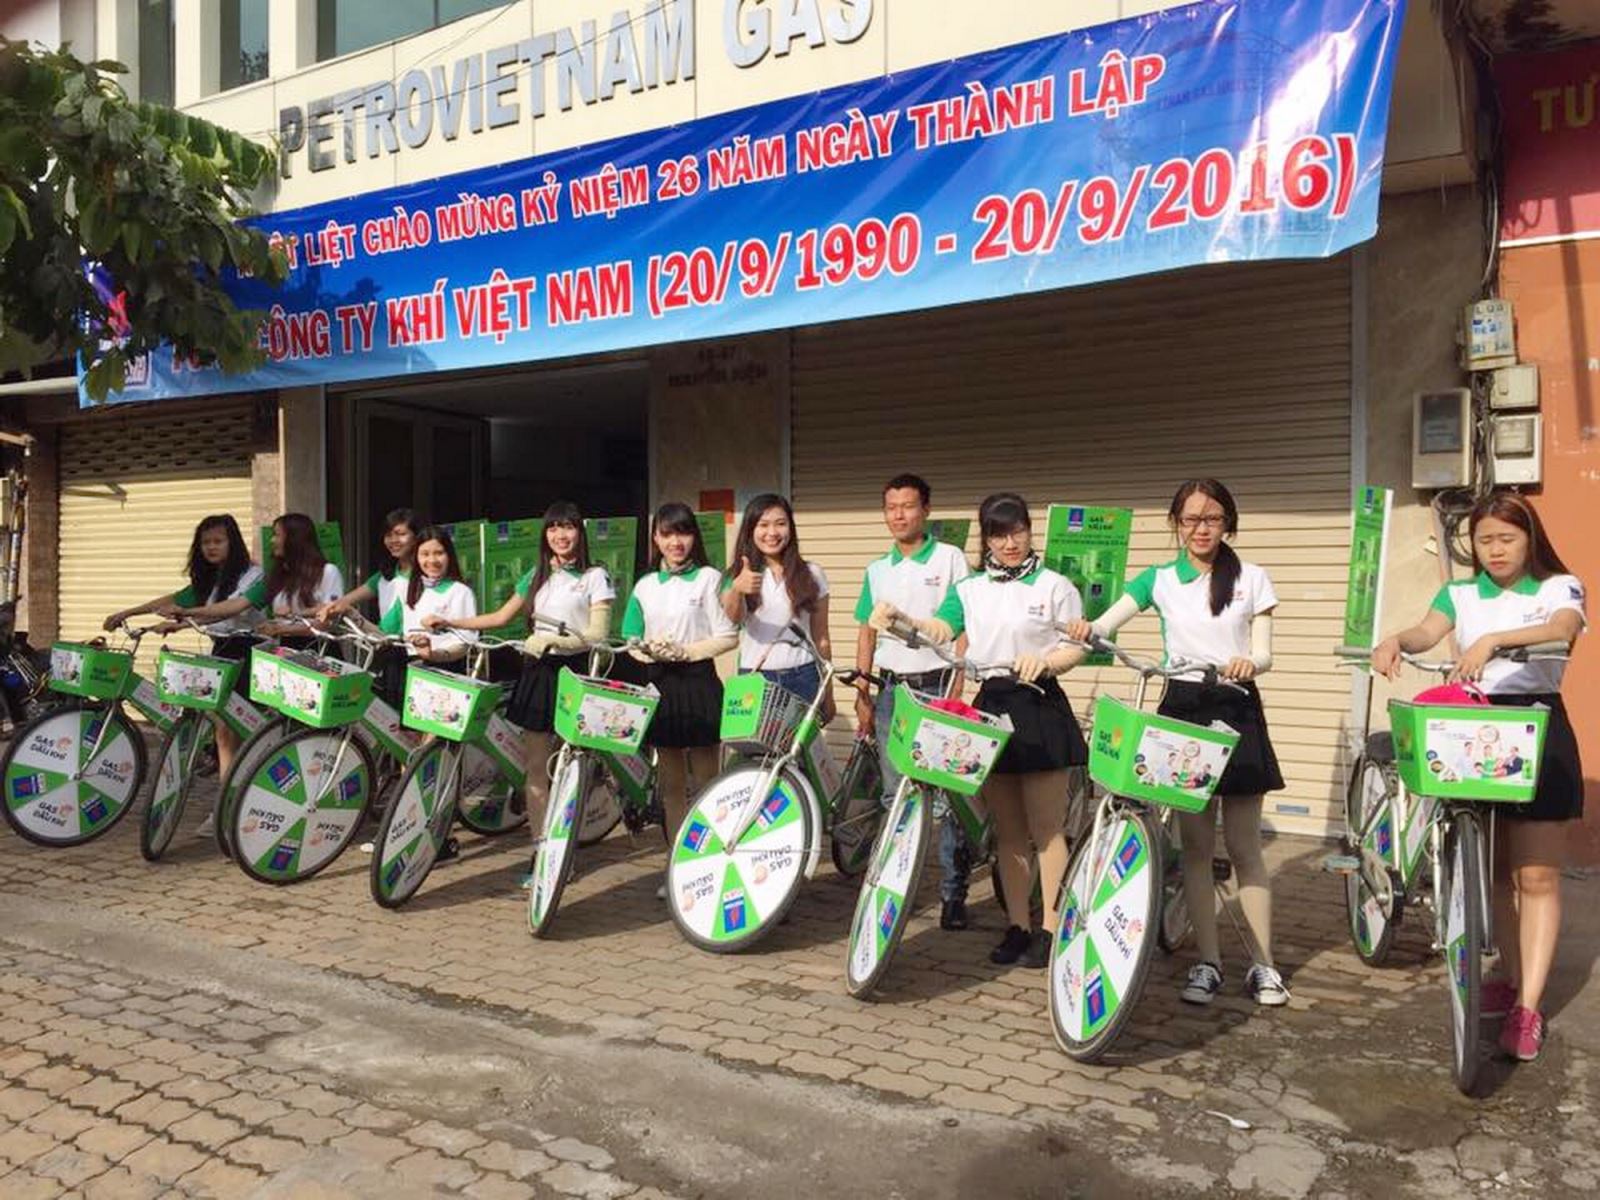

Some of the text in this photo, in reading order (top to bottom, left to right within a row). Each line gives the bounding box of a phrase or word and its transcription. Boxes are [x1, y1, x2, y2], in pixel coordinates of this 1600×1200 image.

[279, 0, 873, 179] PETROVIETNAM GAS
[304, 220, 356, 271] LIỆT
[362, 210, 432, 256] CHÀO
[436, 193, 515, 240] MỪNG
[522, 172, 562, 227] KỶ
[569, 163, 649, 220] NIỆM
[656, 156, 700, 201] 26
[707, 134, 787, 189] NĂM
[796, 109, 899, 173] NGÀY
[909, 76, 1055, 150] THÀNH
[1069, 49, 1166, 119] LẬP
[336, 301, 381, 354] TY
[386, 277, 450, 348] KHÍ
[453, 269, 535, 345] VIỆT
[545, 260, 634, 326] NAM
[646, 211, 922, 317] (20/9/1990
[935, 233, 957, 256] -
[972, 132, 1358, 264] 20/9/2016)
[258, 821, 280, 833] GAS
[769, 856, 792, 872] GAS
[1112, 904, 1129, 931] GAS
